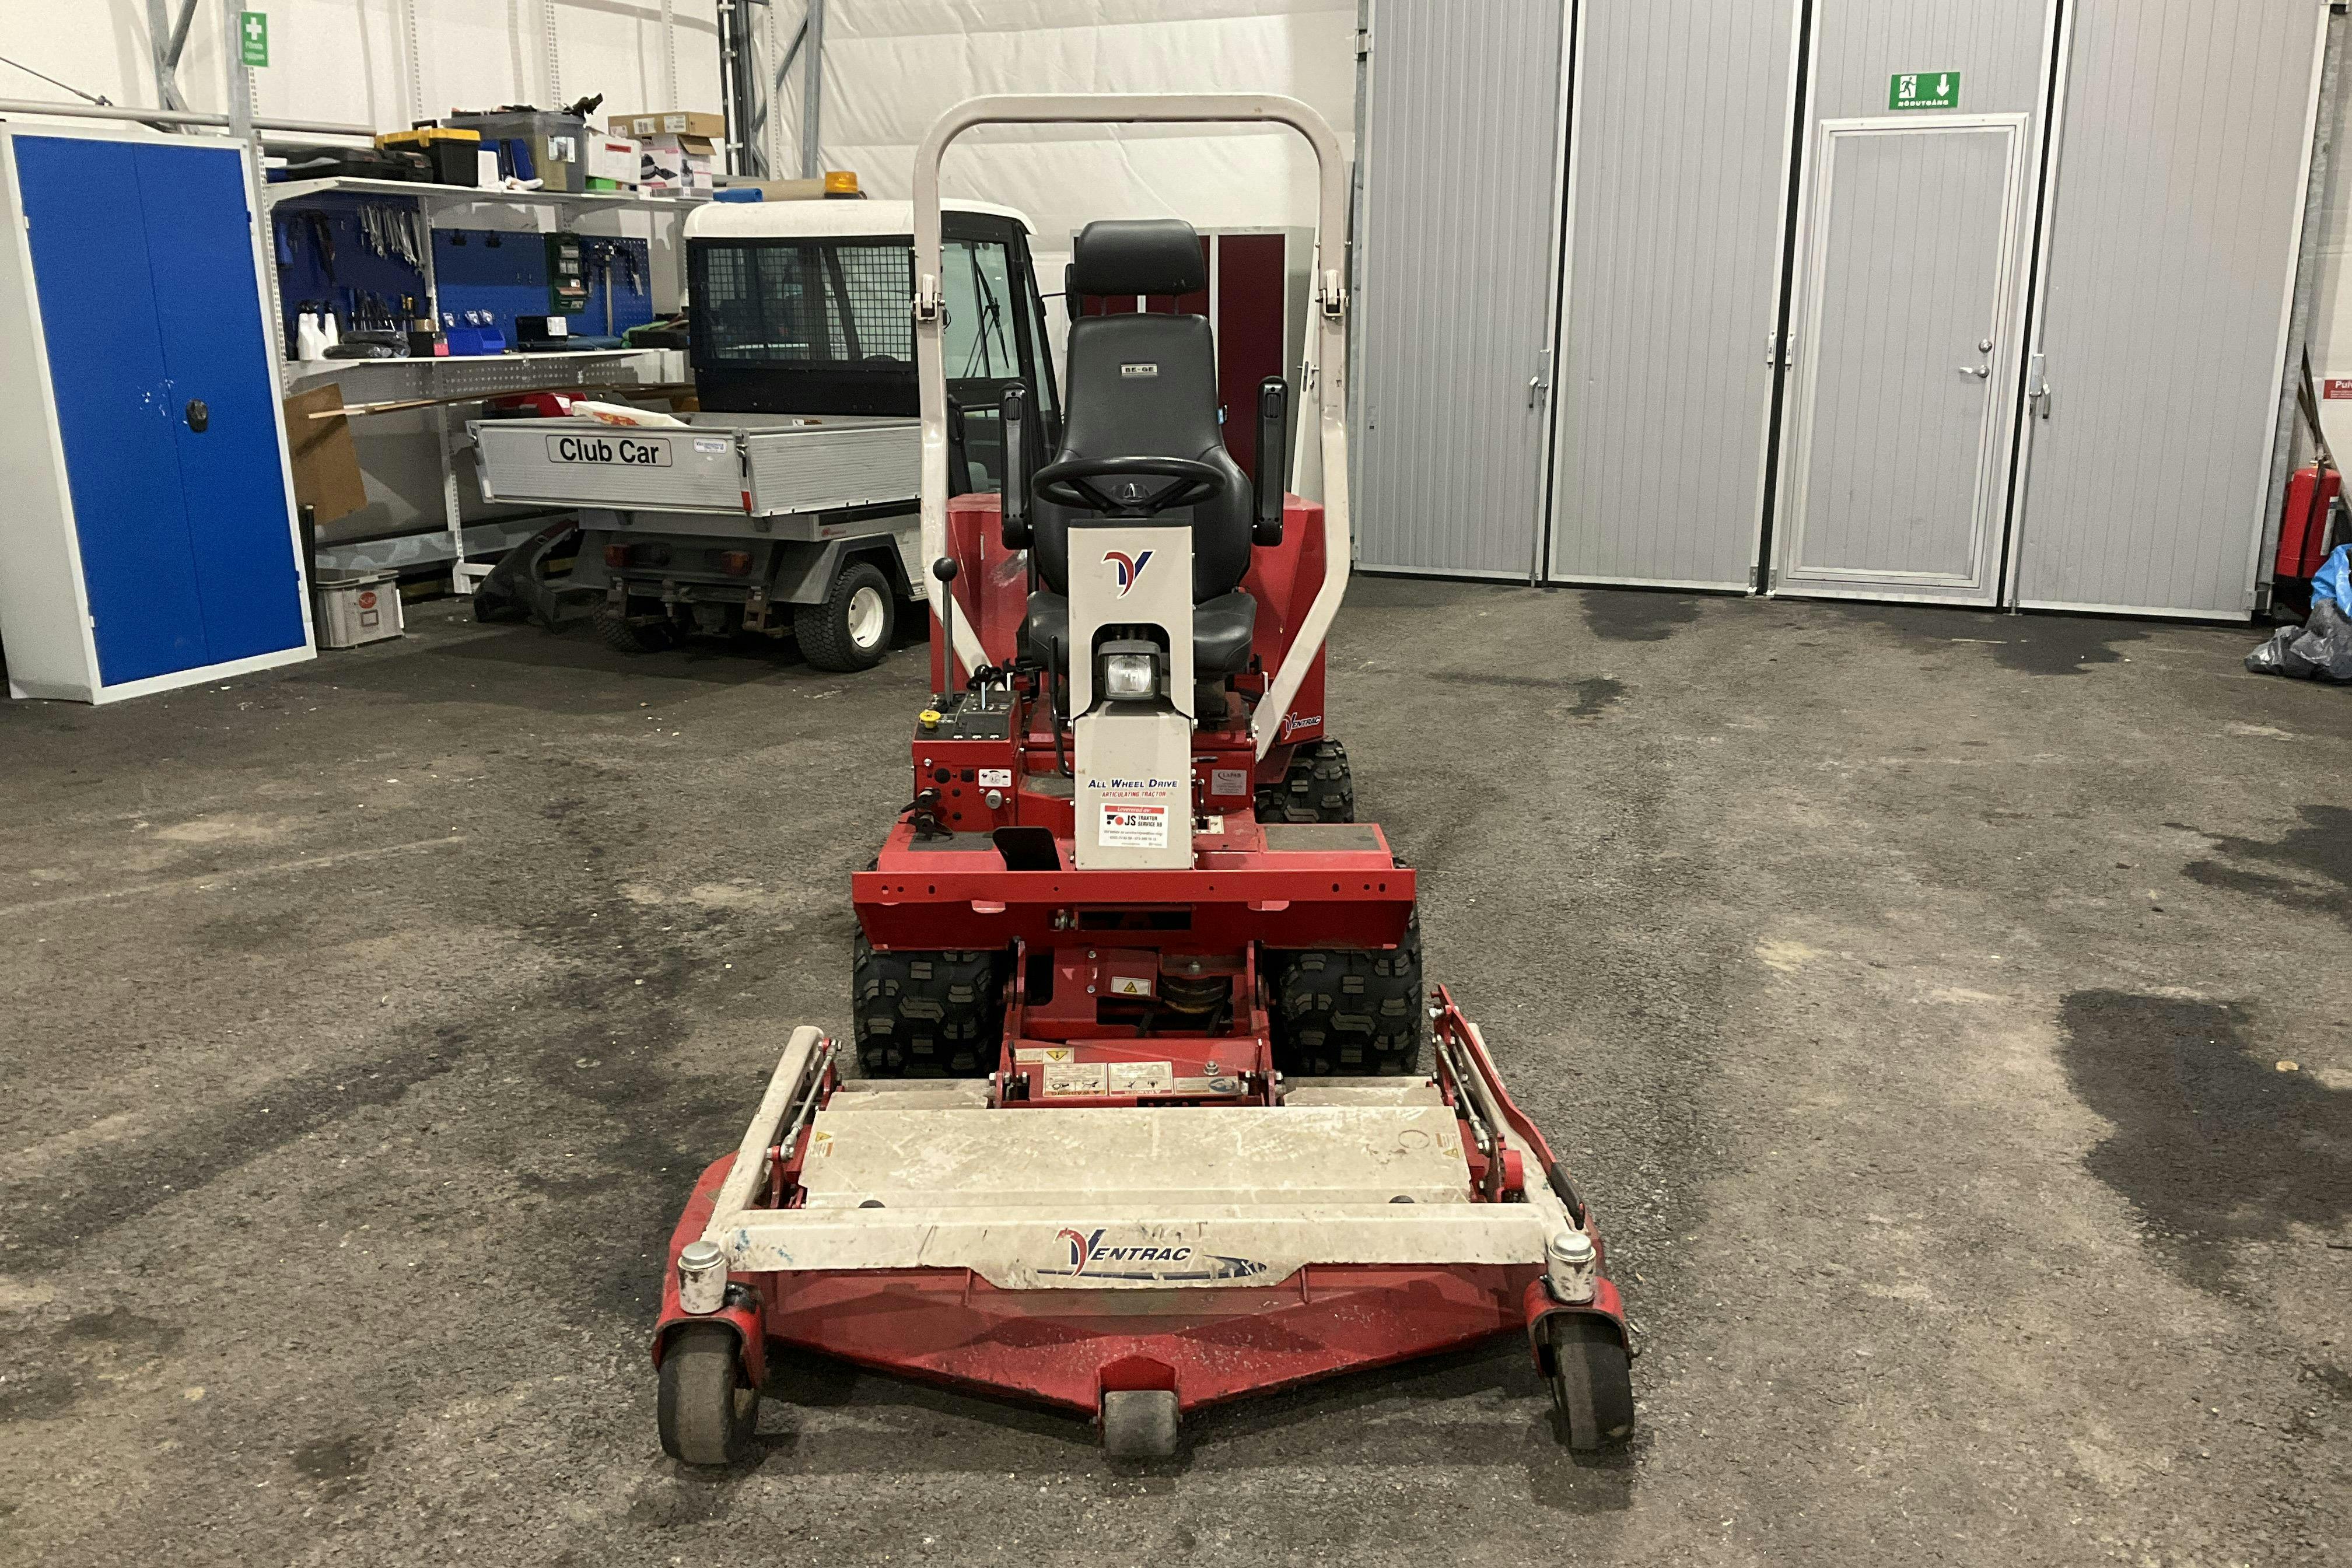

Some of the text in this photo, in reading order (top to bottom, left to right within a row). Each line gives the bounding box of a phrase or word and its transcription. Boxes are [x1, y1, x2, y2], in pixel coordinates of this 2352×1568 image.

[560, 438, 659, 463] Club Car
[1124, 815, 1136, 826] JS
[1052, 1227, 1191, 1279] VENTRAC
